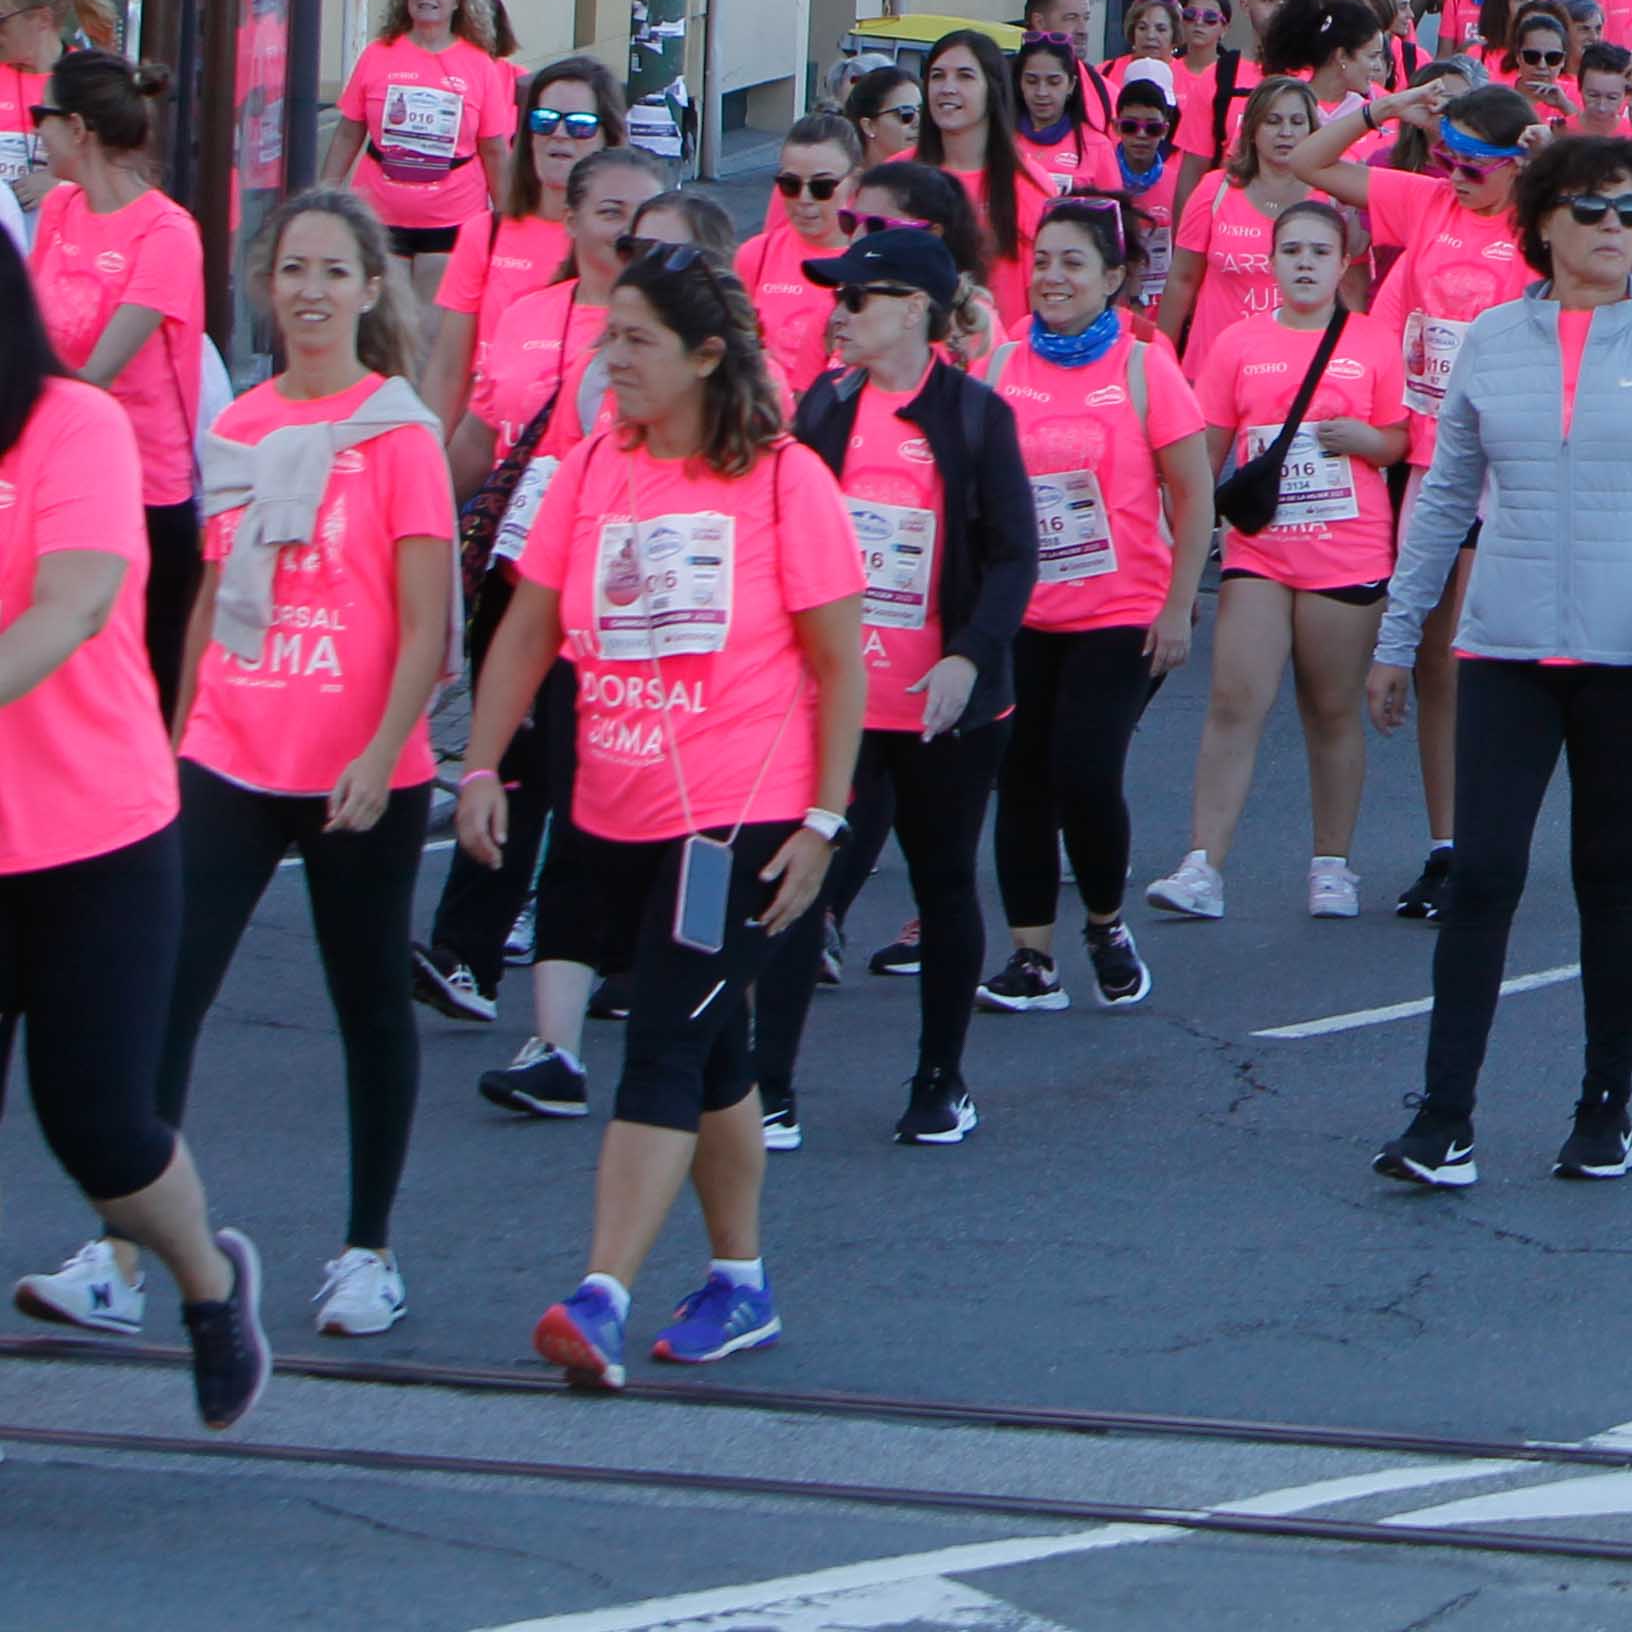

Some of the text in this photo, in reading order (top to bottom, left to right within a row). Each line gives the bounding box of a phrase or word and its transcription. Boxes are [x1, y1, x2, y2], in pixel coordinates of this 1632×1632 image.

[408, 111, 435, 125] 016
[1279, 462, 1316, 478] 016
[645, 569, 677, 594] 06
[577, 671, 707, 713] DORSAL
